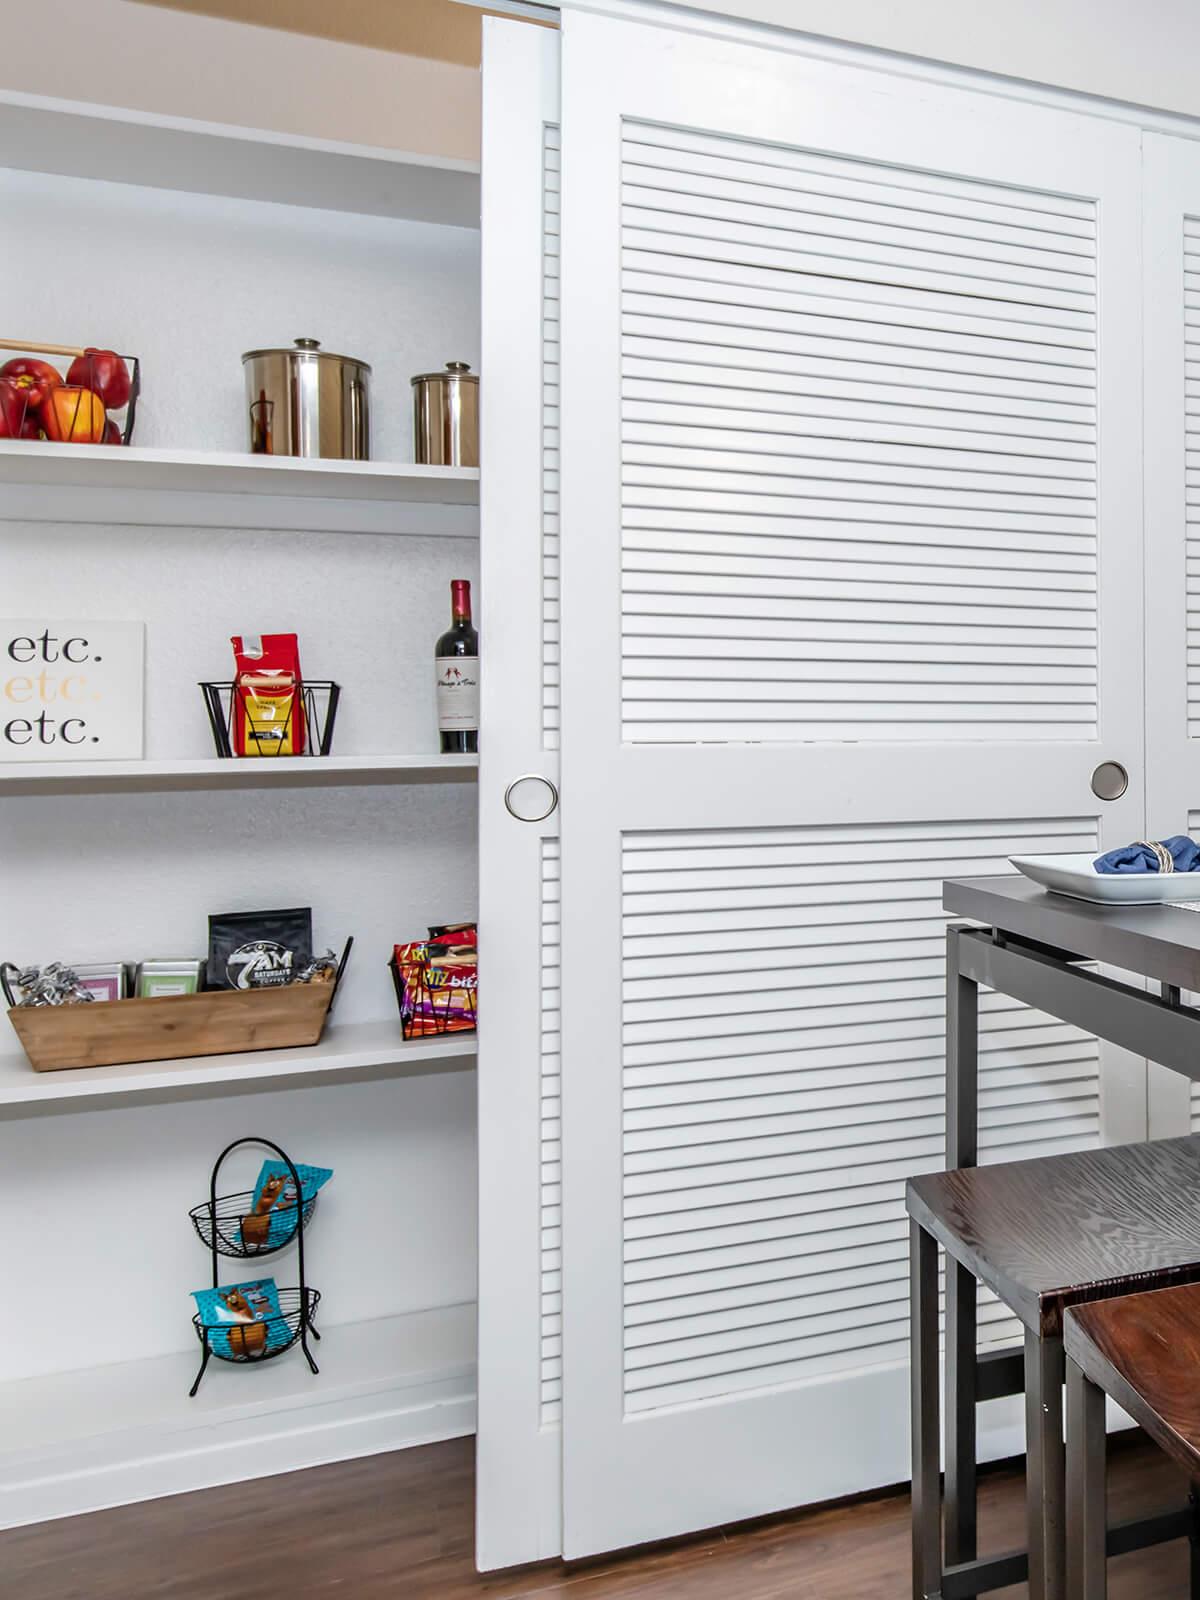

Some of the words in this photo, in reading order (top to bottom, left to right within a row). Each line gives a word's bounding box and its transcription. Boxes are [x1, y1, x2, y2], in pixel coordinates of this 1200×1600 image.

[7, 628, 102, 663] etc.
[4, 667, 103, 704] etc.
[4, 710, 100, 745] etc.
[254, 968, 292, 978] SATURDAYS
